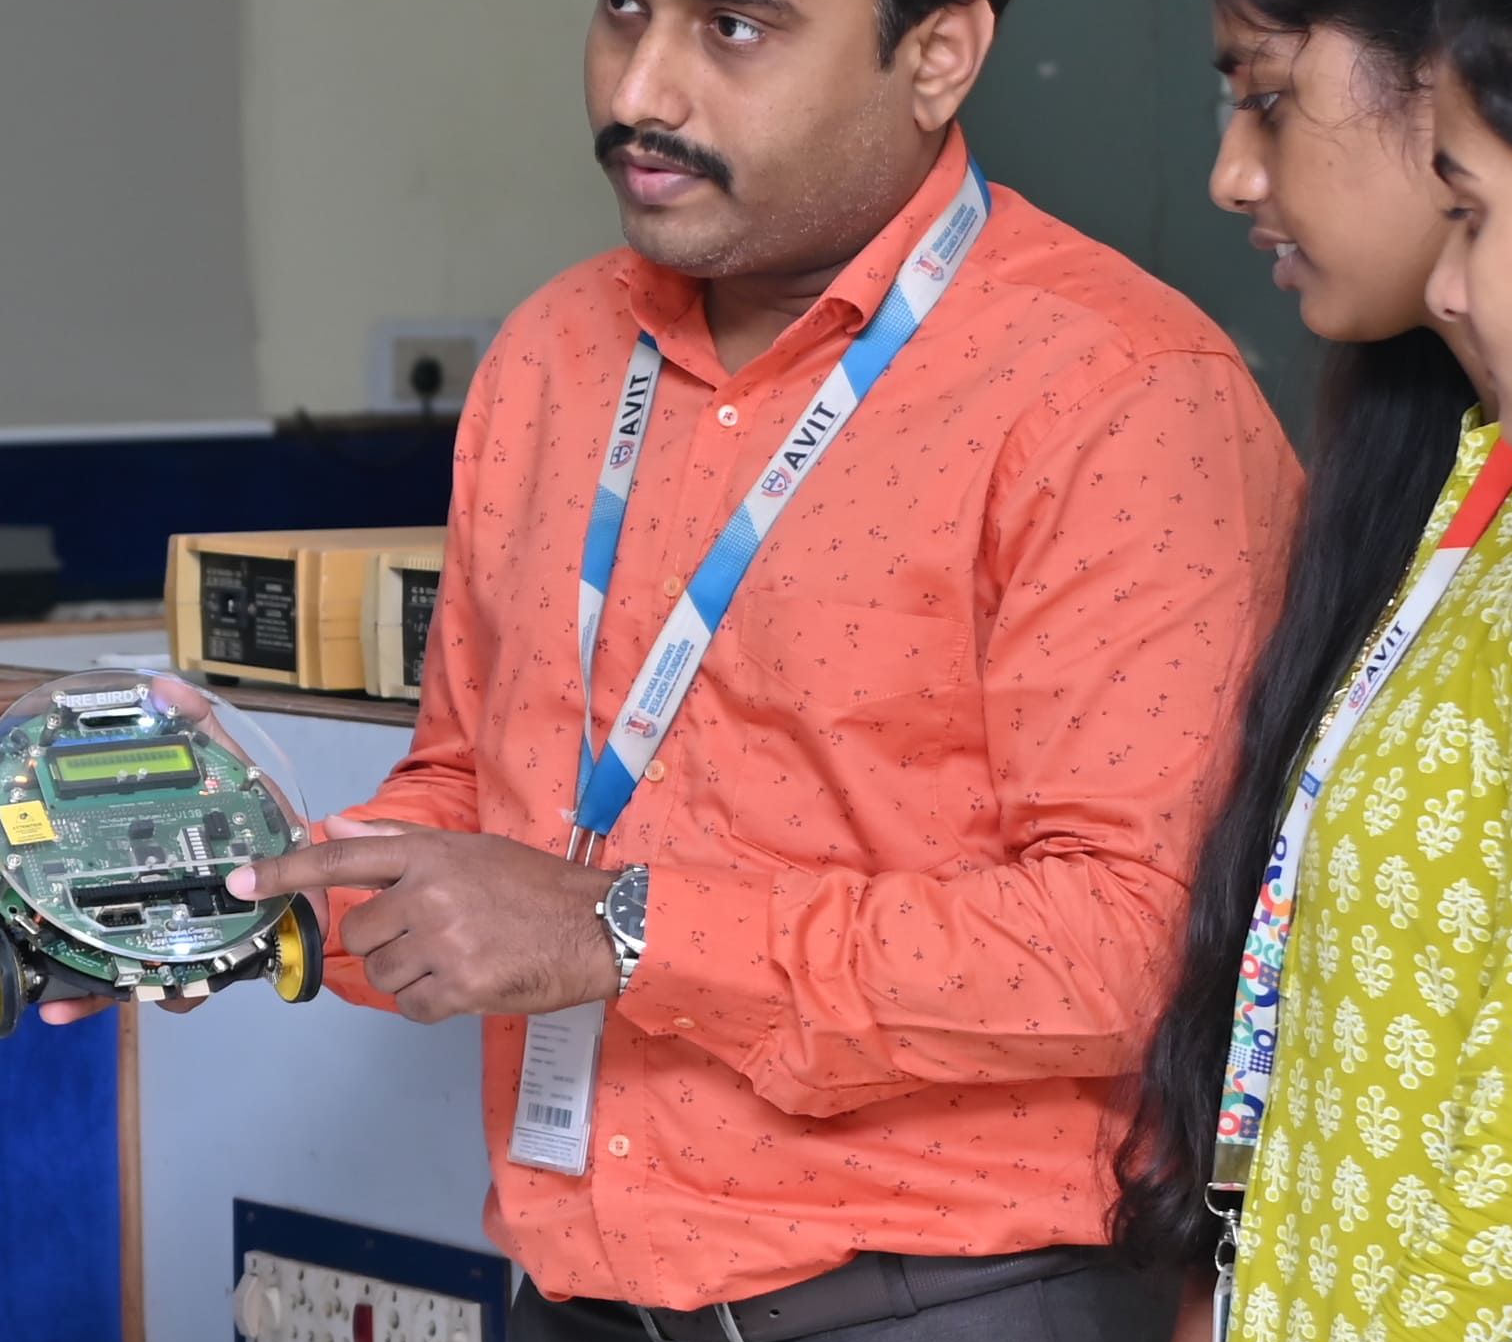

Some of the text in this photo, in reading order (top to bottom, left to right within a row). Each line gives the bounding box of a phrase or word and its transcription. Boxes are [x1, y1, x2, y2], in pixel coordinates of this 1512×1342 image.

[619, 373, 650, 436] AVIT
[782, 401, 836, 471] AVIT
[1365, 620, 1405, 683] AVIT
[55, 694, 92, 708] FIRE
[96, 690, 135, 704] BIRD
